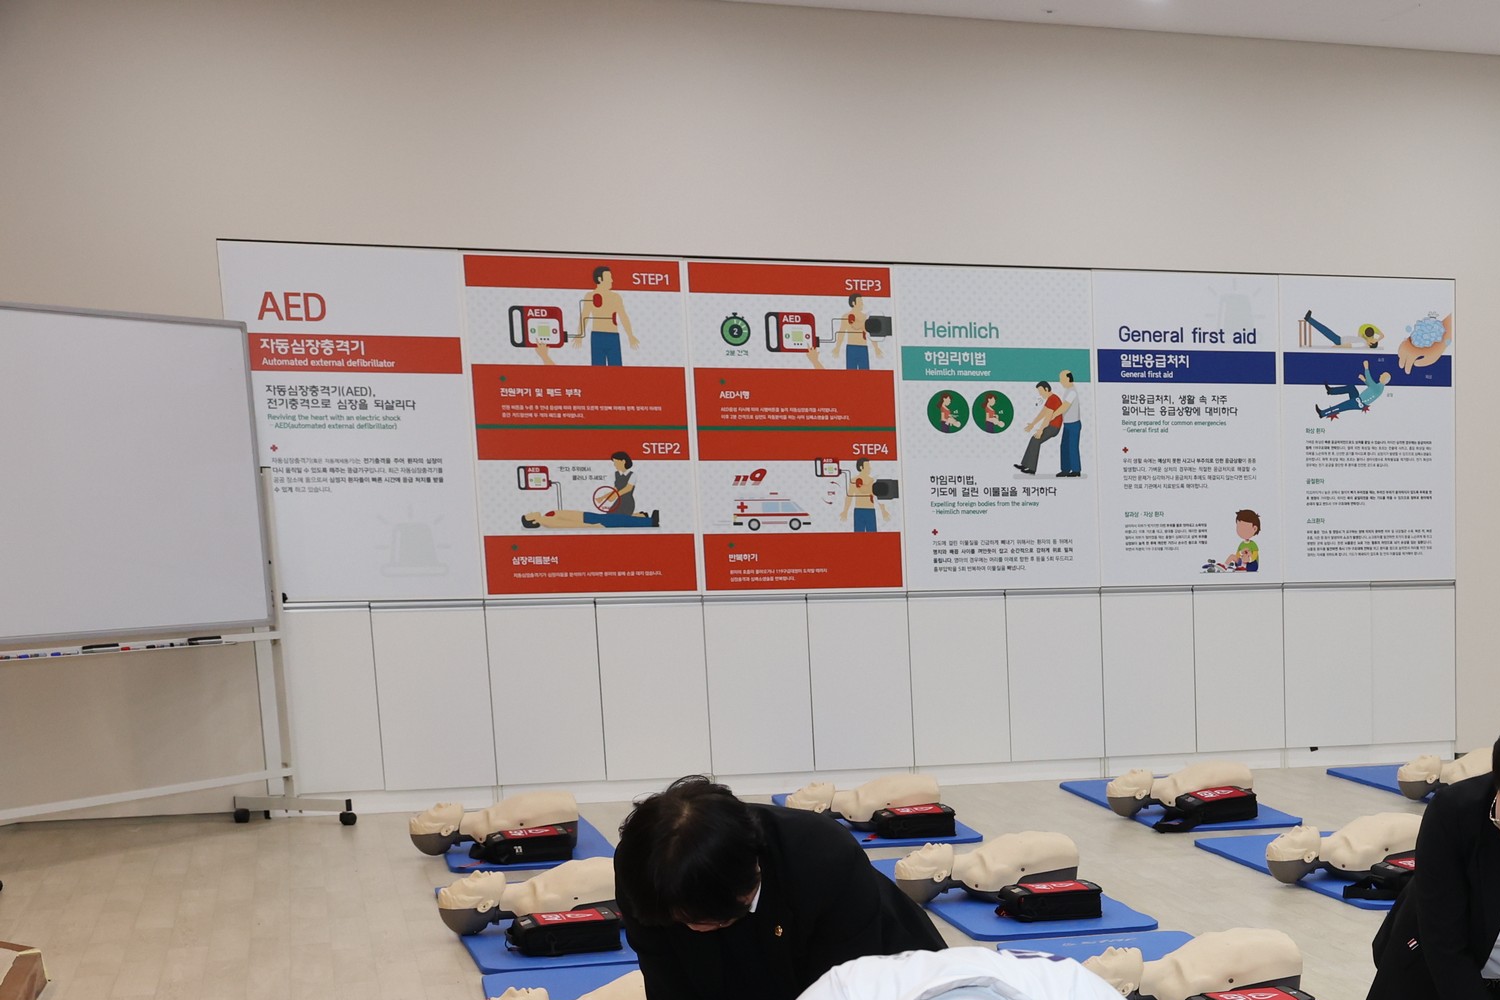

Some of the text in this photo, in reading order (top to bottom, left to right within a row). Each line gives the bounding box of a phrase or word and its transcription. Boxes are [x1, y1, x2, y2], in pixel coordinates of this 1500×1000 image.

[633, 273, 669, 285] STEP1
[845, 279, 881, 291] STEP3
[258, 292, 326, 321] AED
[527, 309, 547, 317] AED
[924, 321, 999, 339] Heimlich
[1119, 326, 1256, 344] General first aid
[260, 339, 364, 355] 자동심장충격기
[262, 357, 395, 367] Automated external defibrillator
[924, 351, 986, 365] 하임리히법
[1121, 354, 1189, 368] 일반응급처치
[925, 368, 955, 376] Heimlich
[720, 391, 749, 399] AED시행
[1179, 395, 1195, 405] 생활
[1199, 395, 1207, 404] 속
[1212, 395, 1227, 404] 자주
[267, 399, 416, 410] 전기충격으로 심장을 되살리다
[1122, 406, 1238, 416] 일어나는 응급상황에 대비하다
[643, 443, 680, 454] STEP2
[853, 444, 888, 454] STEP4
[733, 469, 767, 485] 119
[931, 487, 1057, 497] 기도에 걸린 이물질을 제거하다
